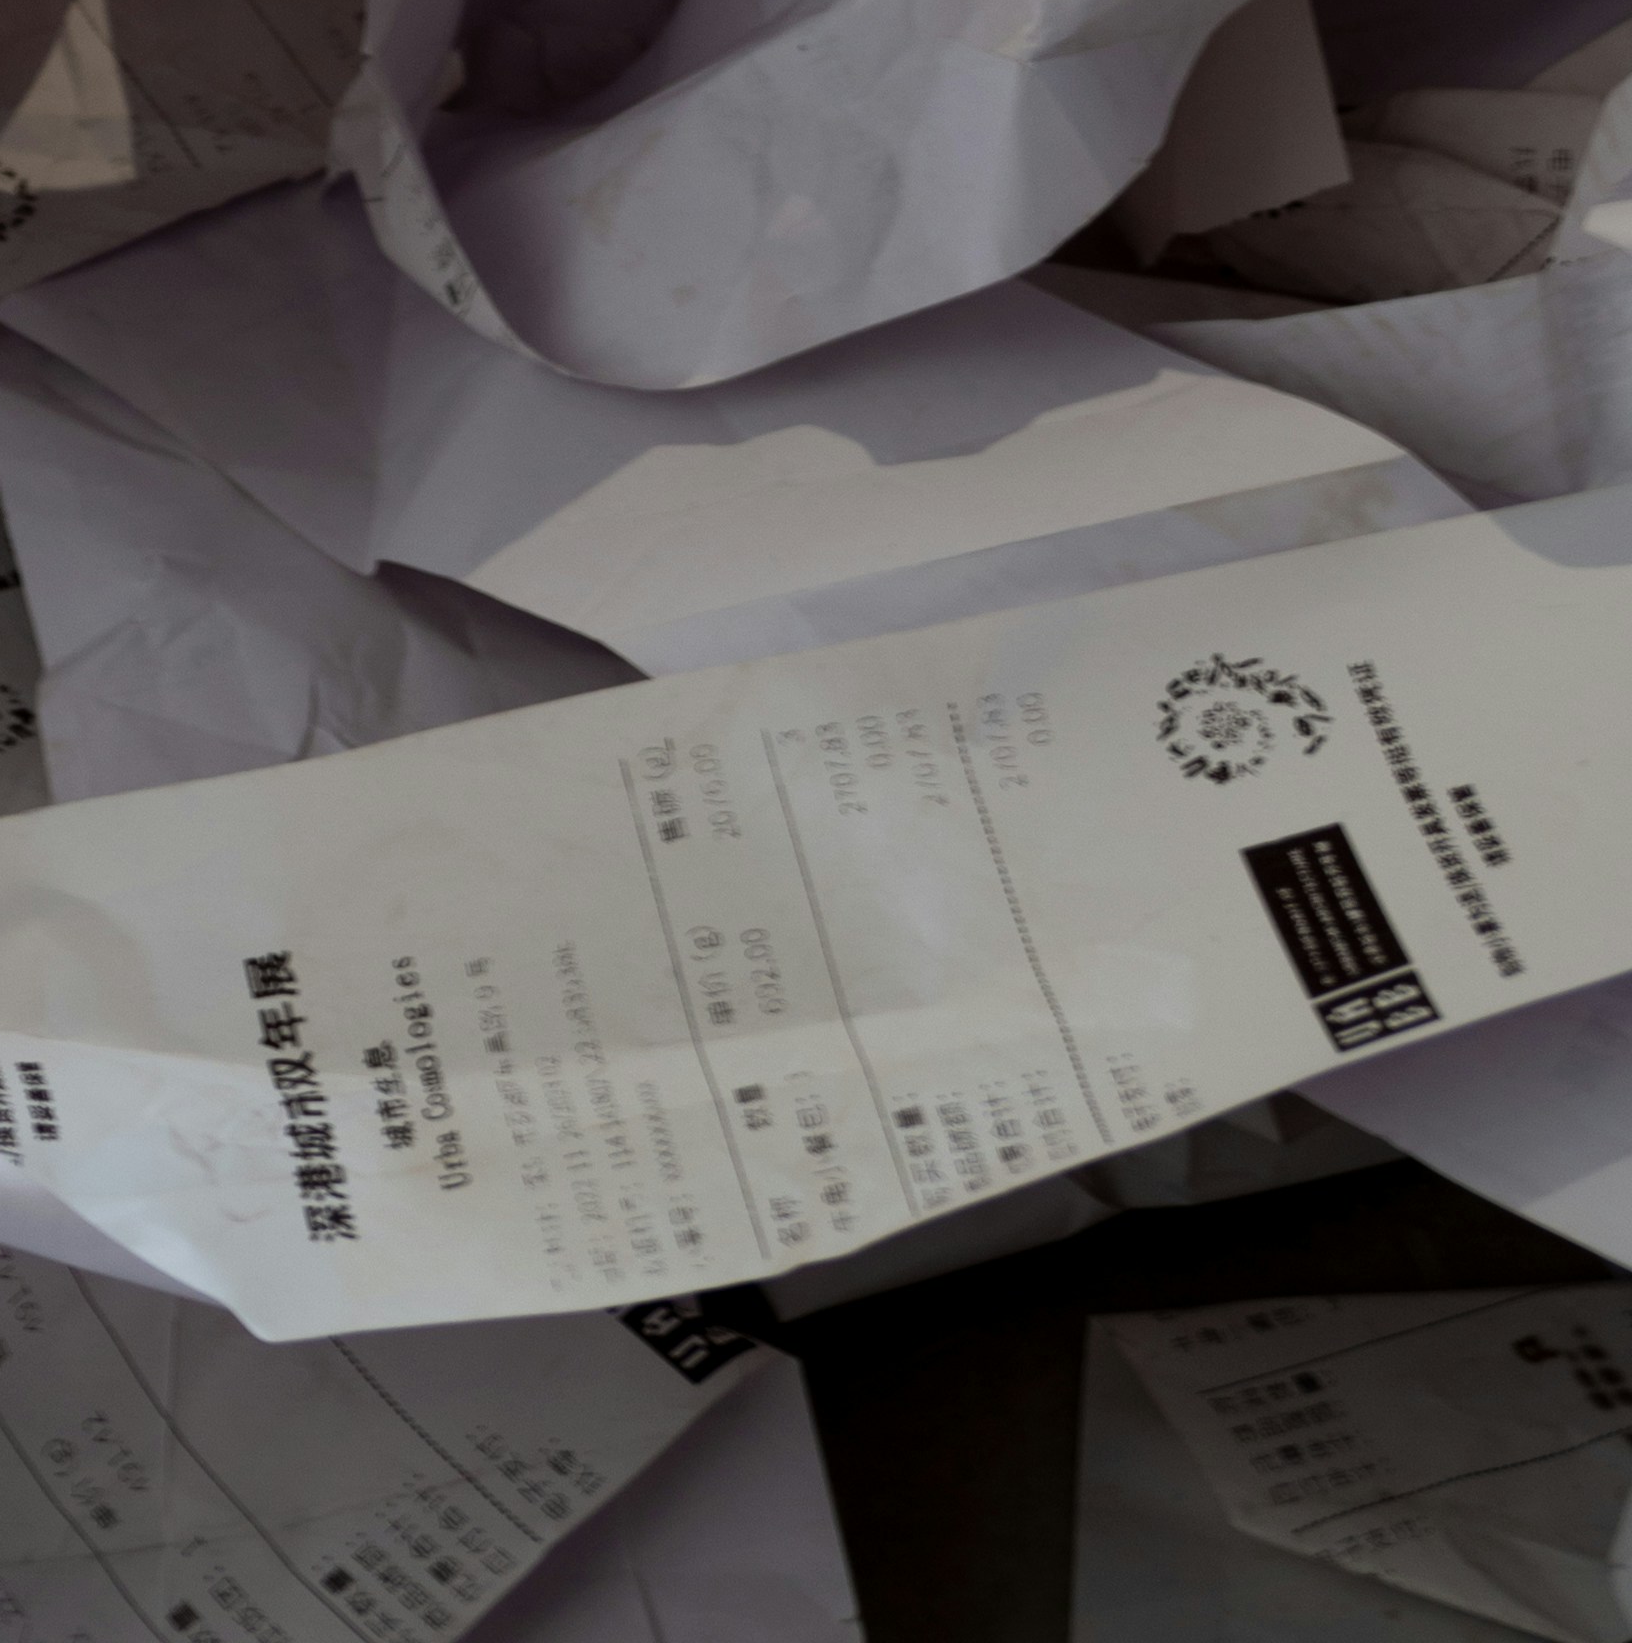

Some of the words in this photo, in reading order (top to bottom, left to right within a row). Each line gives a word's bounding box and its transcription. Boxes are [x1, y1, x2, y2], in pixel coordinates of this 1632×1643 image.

[241, 949, 361, 1243] 深港城市双年展
[357, 1039, 419, 1150] 城市生息
[384, 955, 455, 1121] Cosmologies
